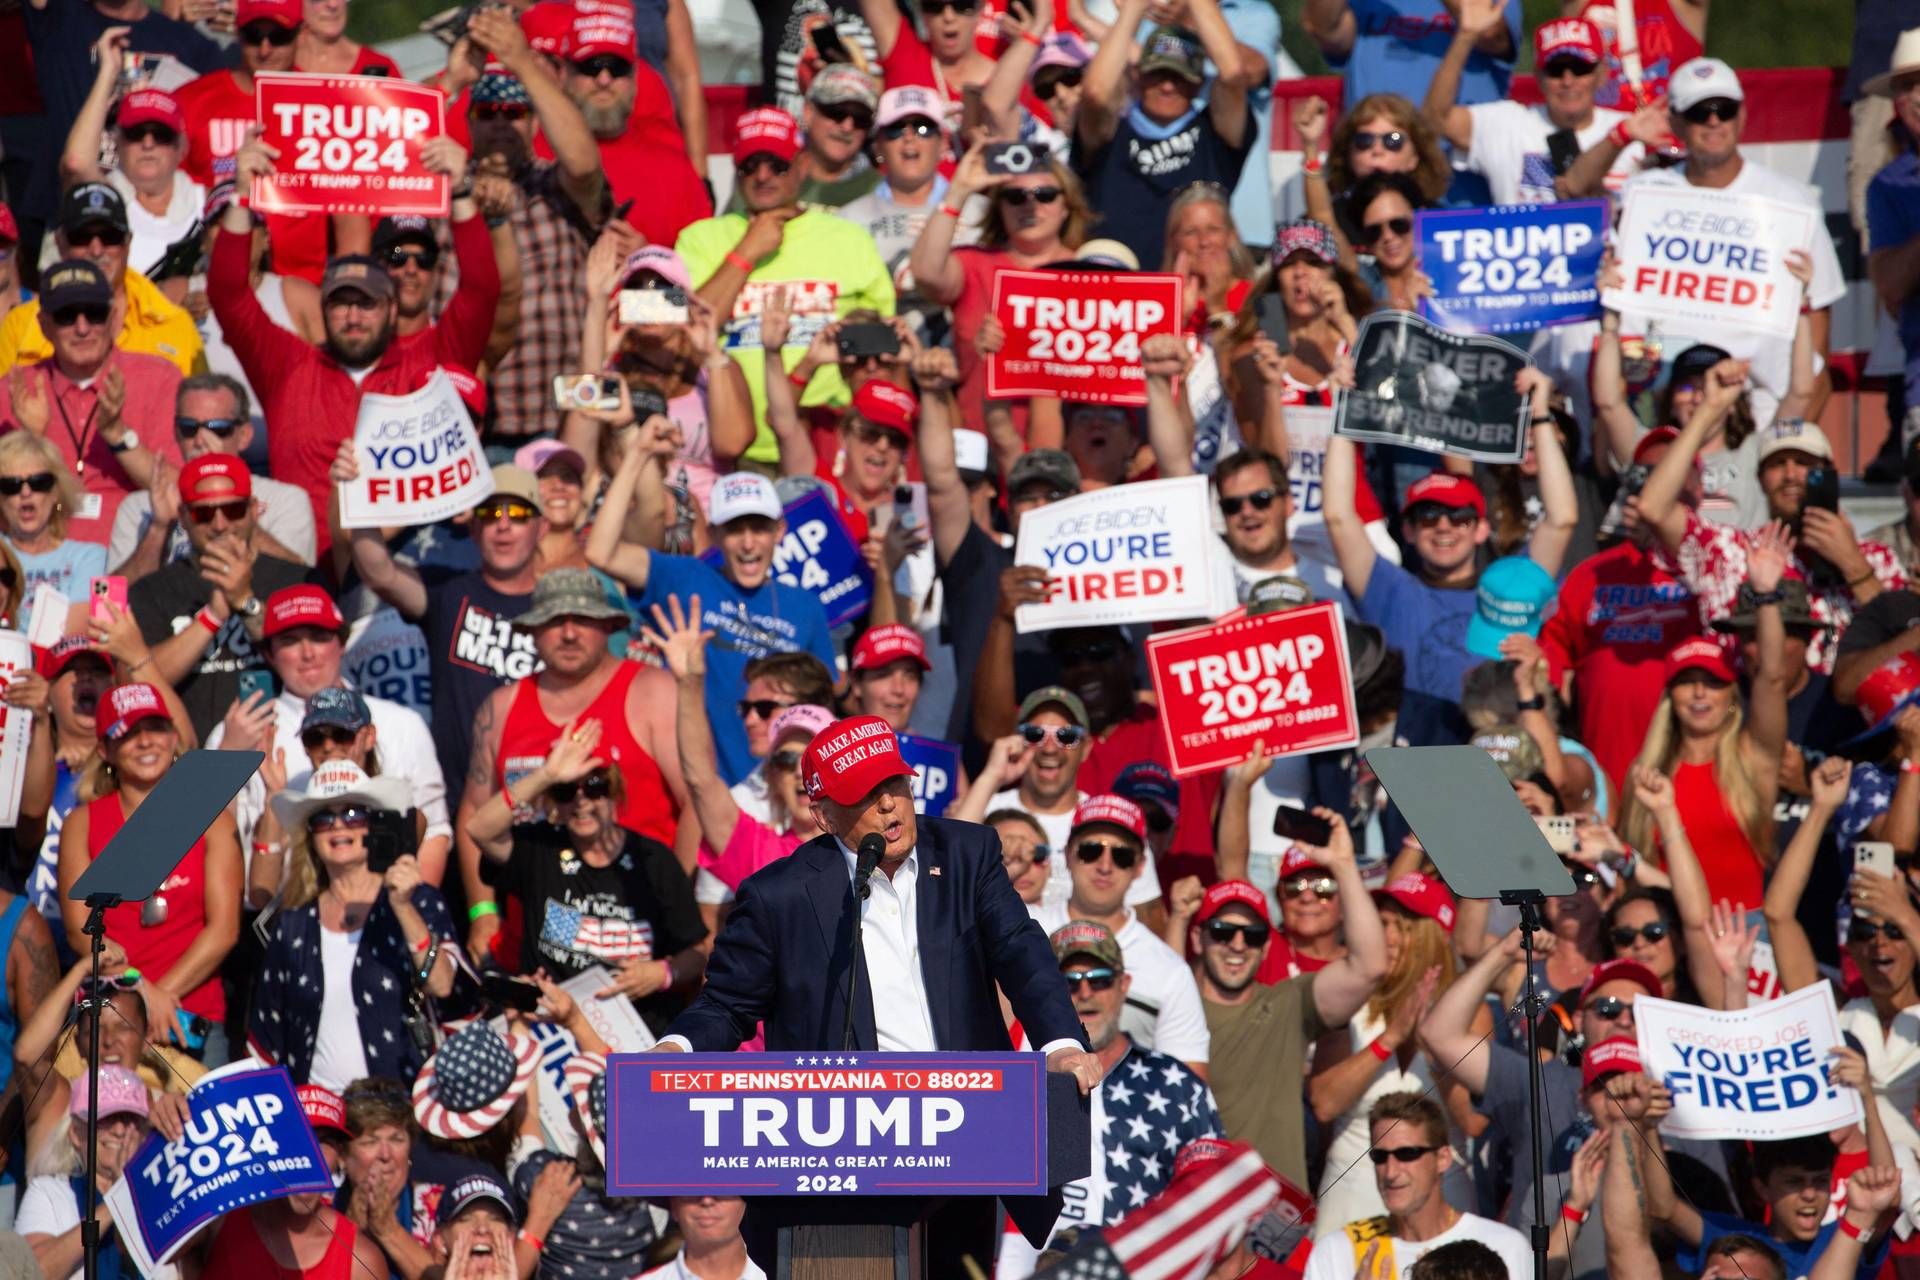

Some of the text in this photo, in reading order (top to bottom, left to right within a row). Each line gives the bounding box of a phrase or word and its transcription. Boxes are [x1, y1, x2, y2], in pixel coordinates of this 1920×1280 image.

[272, 103, 431, 139] TRUMP
[294, 137, 409, 173] 2024
[310, 175, 361, 188] TRUMP
[365, 176, 385, 188] TO
[1653, 209, 1698, 232] JOE
[1433, 223, 1592, 262] TRUMP
[1645, 232, 1769, 274] YOU'RE
[1457, 255, 1572, 294] 2024
[1634, 266, 1775, 310] FIRED!
[1007, 294, 1165, 332] TRUMP
[1475, 294, 1526, 309] TRUMP
[1027, 328, 1142, 363] 2024
[1366, 328, 1508, 383] NEVER
[1003, 360, 1040, 374] TEXT
[1044, 362, 1095, 378] TRUMP
[1098, 365, 1118, 379] TO
[368, 420, 467, 470] YOU'RE
[370, 416, 418, 441] JOE
[367, 449, 480, 505] FIRED!
[1049, 503, 1168, 538] JOE BIDEN
[1043, 532, 1172, 568] YOU'RE
[1041, 566, 1184, 605] FIRED!
[1169, 634, 1324, 695] TRUMP
[1199, 671, 1312, 726] 2024
[817, 721, 893, 762] MAKE AMERICA
[1181, 729, 1219, 749] TEXT
[1220, 716, 1273, 741] TRUMP
[1275, 711, 1296, 728] TO
[833, 745, 868, 775] GREAT
[1666, 1019, 1809, 1051] CROOKED JOE
[1673, 1037, 1816, 1078] YOU'RE
[661, 1072, 994, 1090] TEXT PENNSYLVANIA TO 88022
[1663, 1063, 1838, 1113] FIRED!
[142, 1092, 284, 1187] TRUMP
[689, 1097, 966, 1147] TRUMP
[166, 1126, 280, 1200] 2024
[703, 1156, 952, 1168] MAKE AMERICA GREAT AGAIN!
[155, 1197, 186, 1230] TEXT
[188, 1169, 241, 1201] TRUMP
[242, 1161, 265, 1178] TO
[451, 1179, 505, 1202] TRUMP
[796, 1174, 859, 1192] 2024
